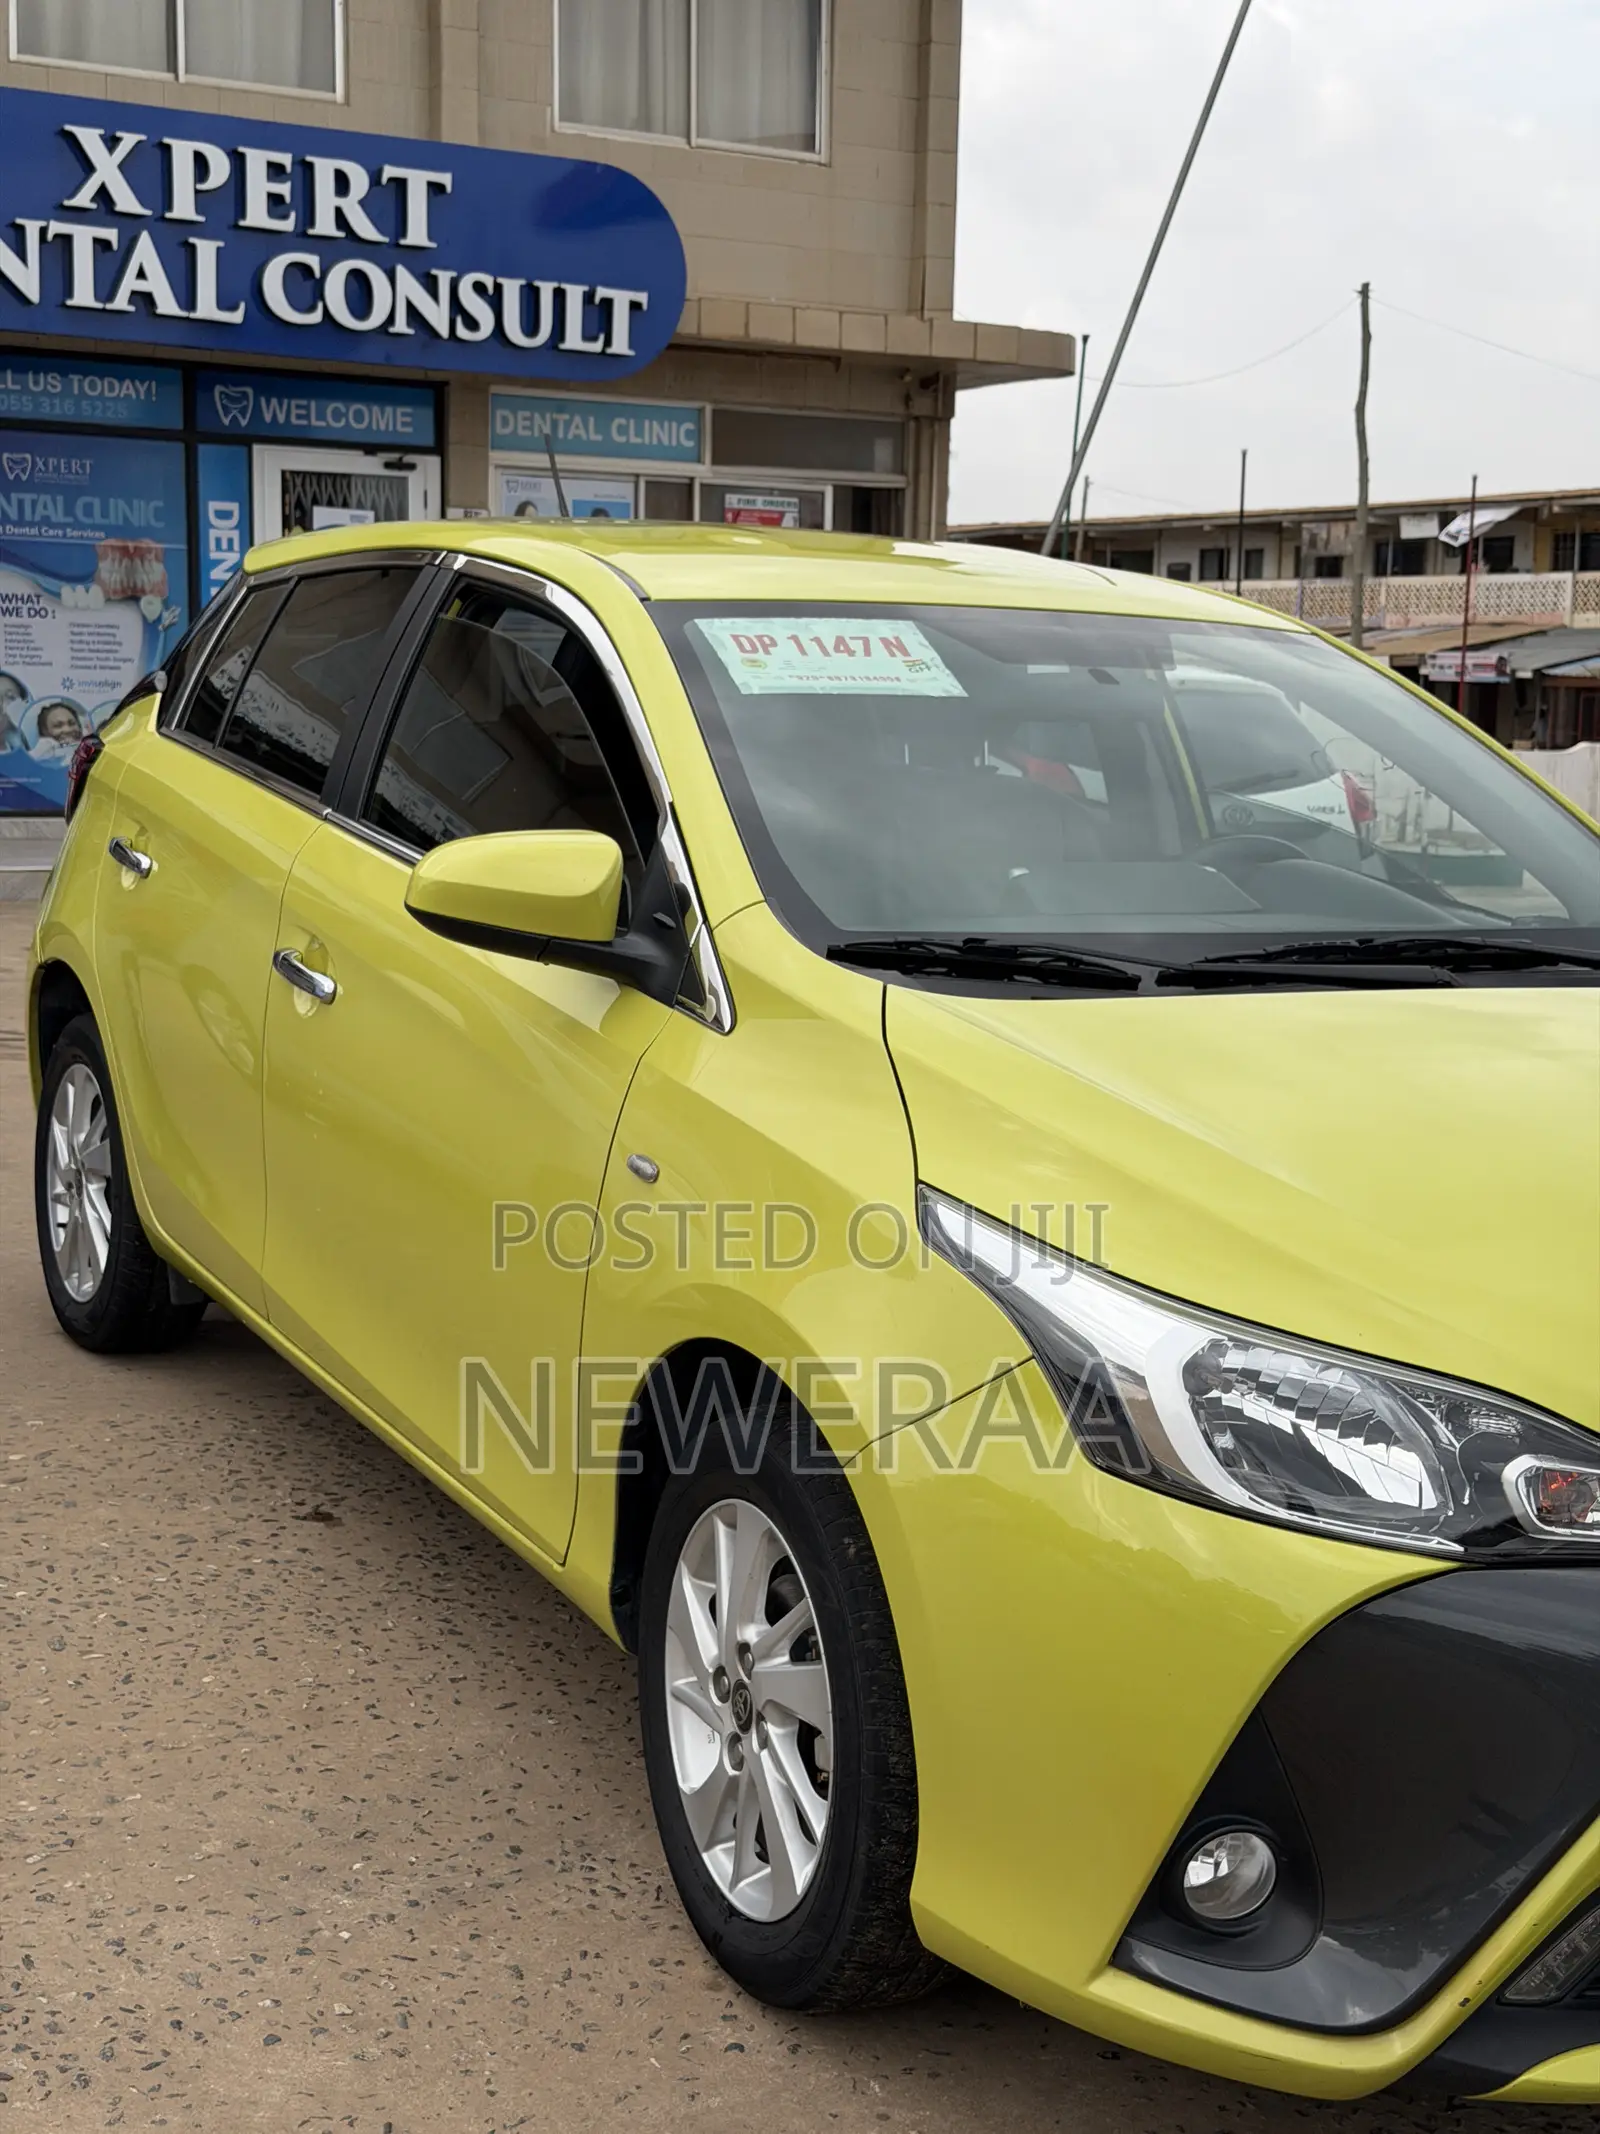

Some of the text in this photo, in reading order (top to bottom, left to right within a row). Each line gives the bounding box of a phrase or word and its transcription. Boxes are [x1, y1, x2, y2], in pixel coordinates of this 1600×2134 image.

[62, 124, 453, 249] XPERT
[0, 217, 649, 356] NTAL CONSULT
[28, 371, 62, 393] US
[68, 374, 157, 402] TODAY!
[260, 396, 414, 432] WELCOME
[494, 409, 696, 448] DENTAL CLINIC
[36, 456, 93, 475] XPERT
[75, 495, 165, 528] CLINIC
[6, 524, 39, 536] Dental
[208, 500, 241, 598] DEN
[0, 593, 42, 605] WHAT
[0, 605, 23, 619] WE
[730, 634, 914, 658] DP 1147 N
